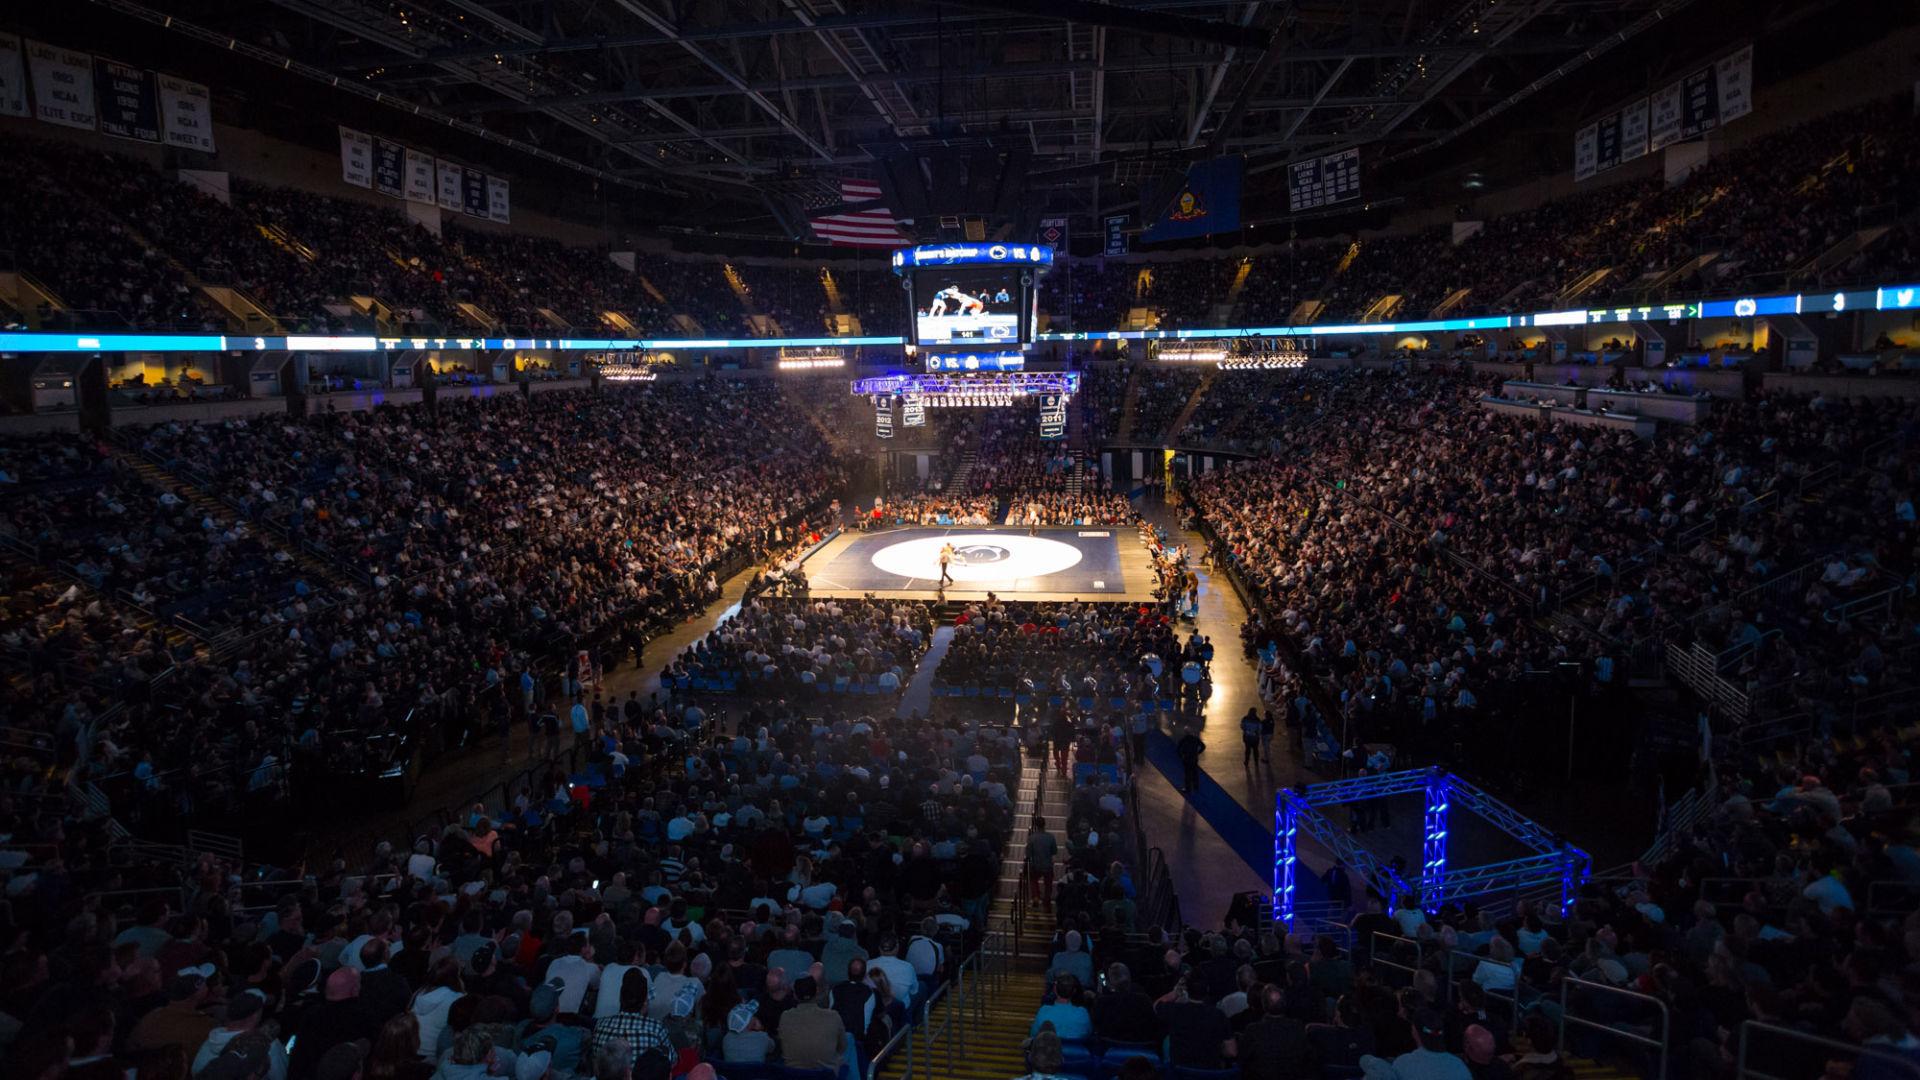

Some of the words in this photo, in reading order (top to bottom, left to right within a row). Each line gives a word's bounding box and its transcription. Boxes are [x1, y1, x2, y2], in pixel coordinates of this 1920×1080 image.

[30, 46, 56, 61] LADY
[62, 55, 91, 69] LIONS
[107, 63, 144, 81] NITTANY
[113, 80, 140, 95] LIONS
[40, 105, 66, 119] ELITE
[103, 121, 130, 136] FINAL
[134, 127, 158, 141] FOUR
